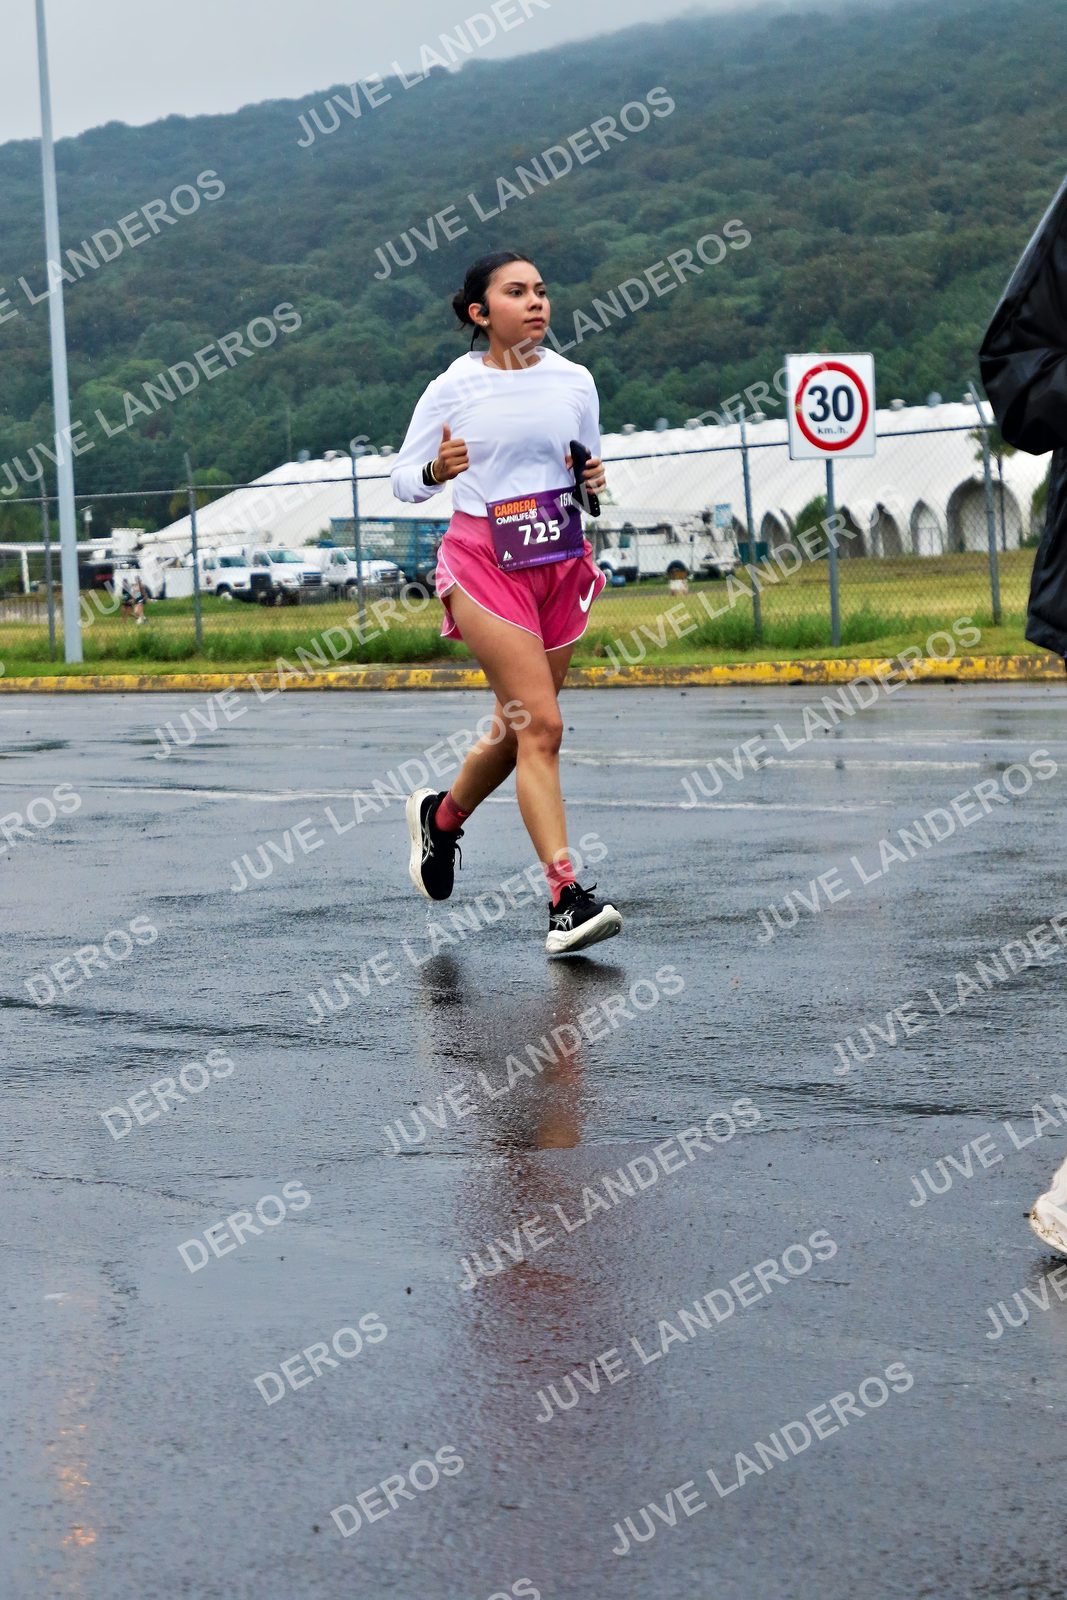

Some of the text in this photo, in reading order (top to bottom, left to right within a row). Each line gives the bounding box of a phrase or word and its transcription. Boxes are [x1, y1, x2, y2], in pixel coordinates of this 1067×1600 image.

[808, 384, 855, 422] 30
[495, 498, 537, 517] CARRERA
[518, 520, 561, 545] 725
